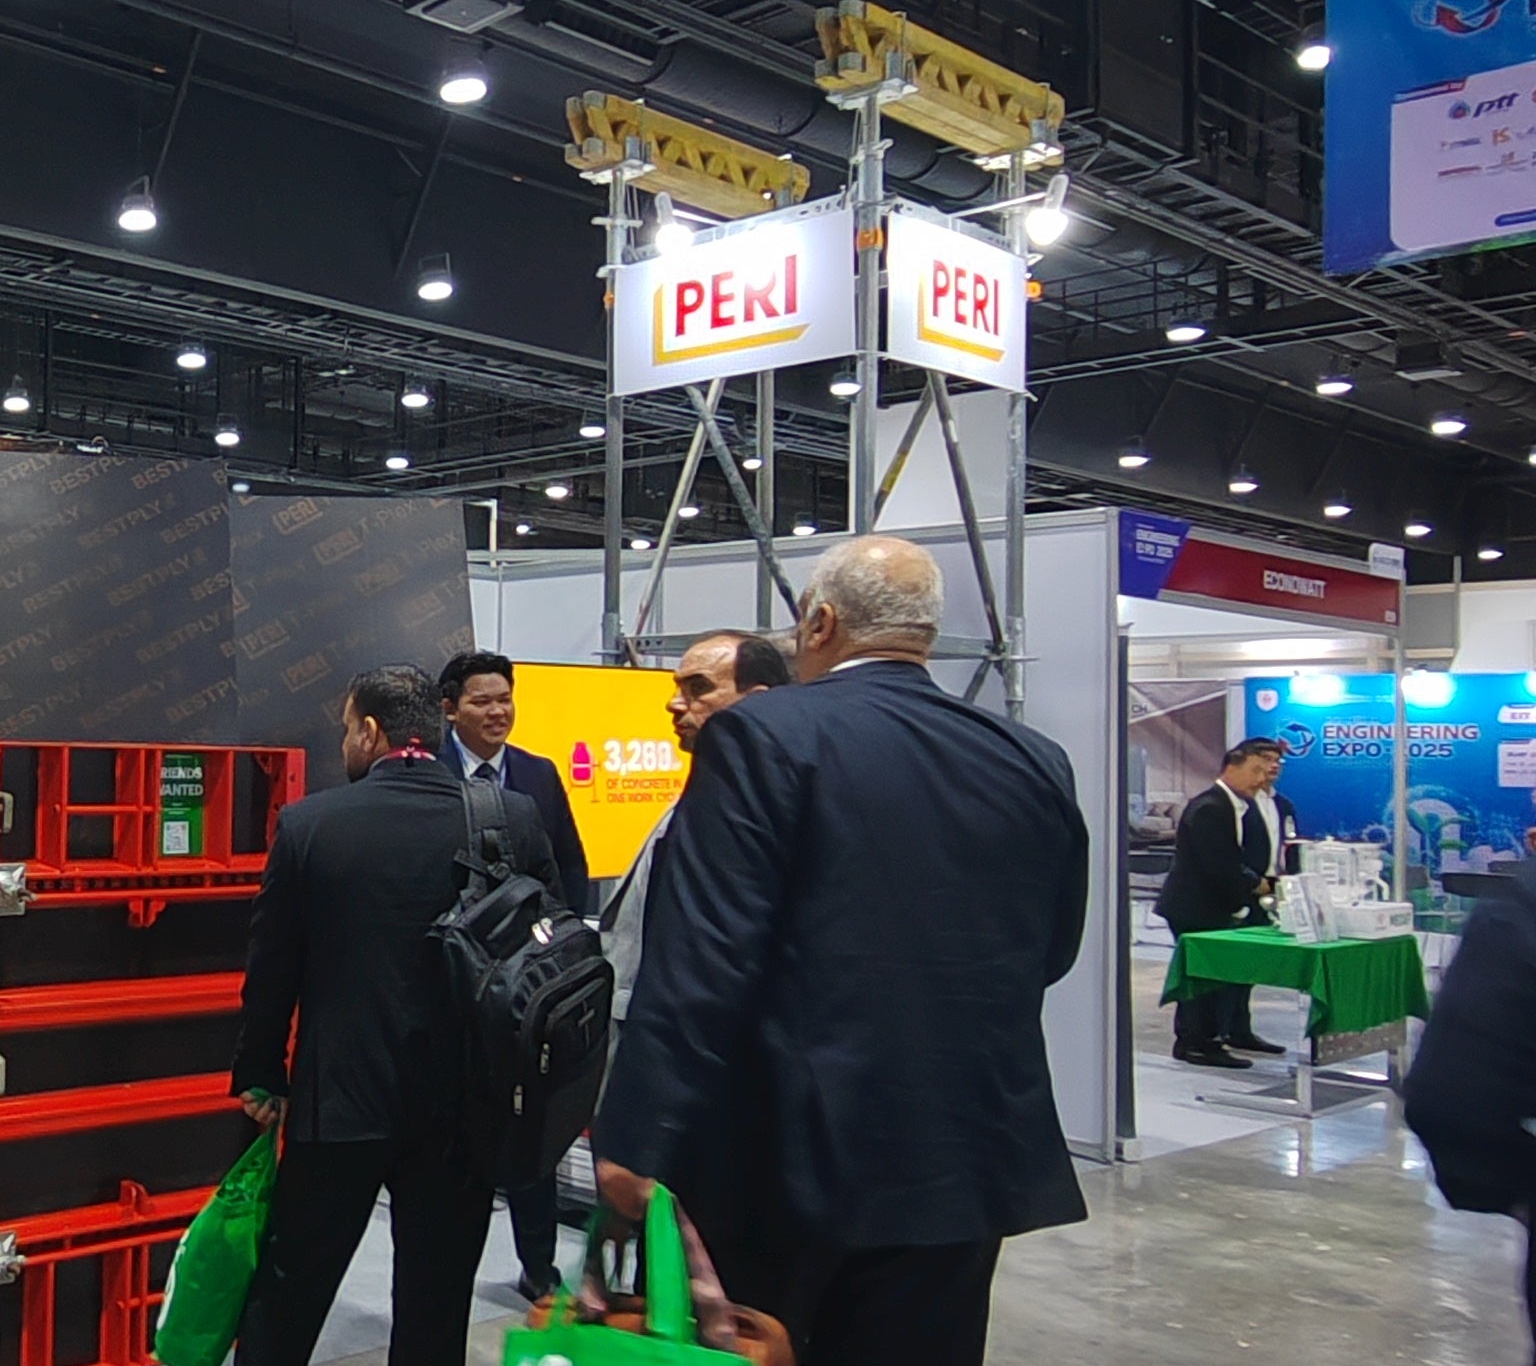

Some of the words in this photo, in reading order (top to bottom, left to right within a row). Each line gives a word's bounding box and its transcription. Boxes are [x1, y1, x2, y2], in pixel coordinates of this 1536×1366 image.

[1472, 91, 1521, 118] ptt
[675, 254, 797, 337] PERI
[932, 259, 1000, 336] PERI
[49, 455, 126, 495] BESTPL
[1323, 724, 1479, 740] ENGINERING
[1323, 742, 1383, 758] EXPO
[1404, 743, 1453, 758] 025
[160, 766, 203, 779] RIENDS
